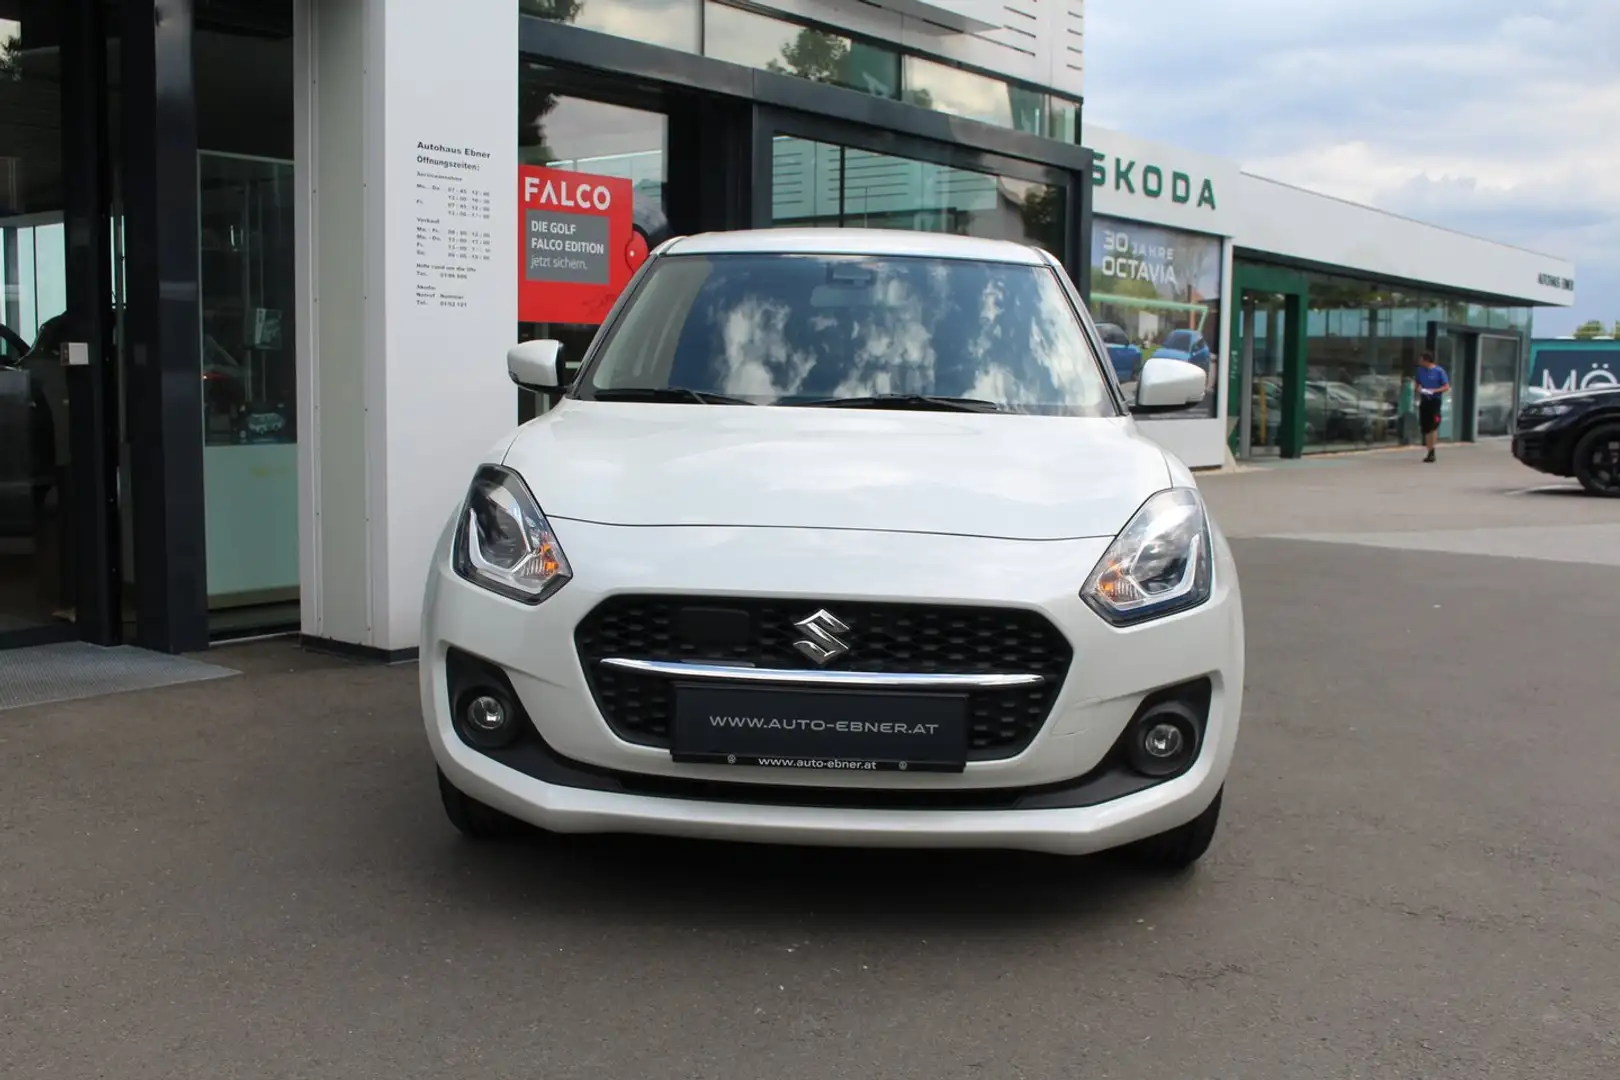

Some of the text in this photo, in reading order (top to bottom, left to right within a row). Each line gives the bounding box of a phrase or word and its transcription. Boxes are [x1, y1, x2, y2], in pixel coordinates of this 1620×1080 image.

[417, 141, 490, 158] Autohaus Ebner
[524, 176, 611, 211] FALCO
[531, 220, 576, 235] DIE GOLF
[531, 238, 604, 254] FALCO EDITION
[1103, 231, 1175, 260] 30 JAHRE
[530, 255, 551, 270] jetzt
[1102, 255, 1177, 286] OCTAVIA
[709, 715, 939, 735] WWW.AUTO-EBNER.AT
[758, 756, 877, 770] www.auto-ebner.at
